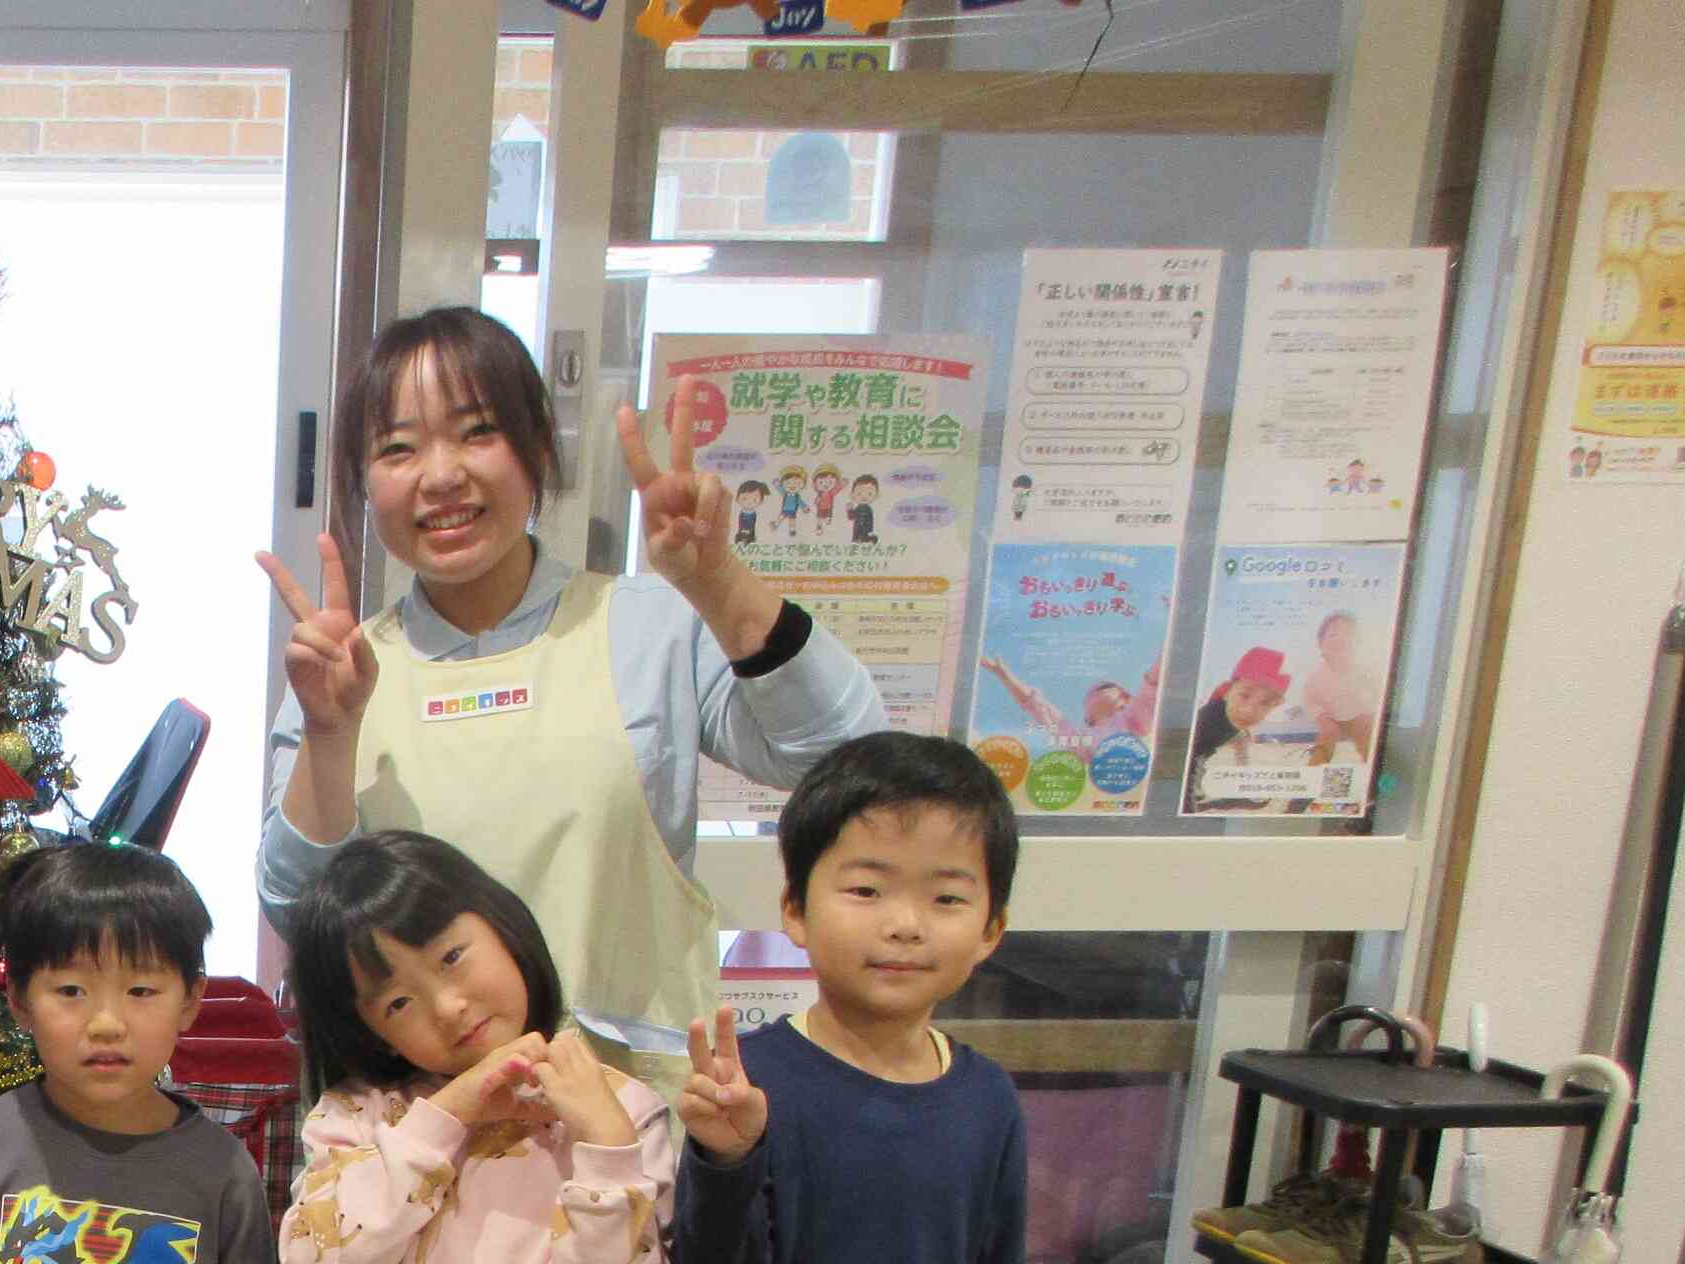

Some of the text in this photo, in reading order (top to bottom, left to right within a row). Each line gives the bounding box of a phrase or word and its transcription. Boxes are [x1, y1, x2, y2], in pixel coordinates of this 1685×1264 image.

[729, 372, 926, 409] 就学や教育に
[768, 413, 962, 450] 関する相談会
